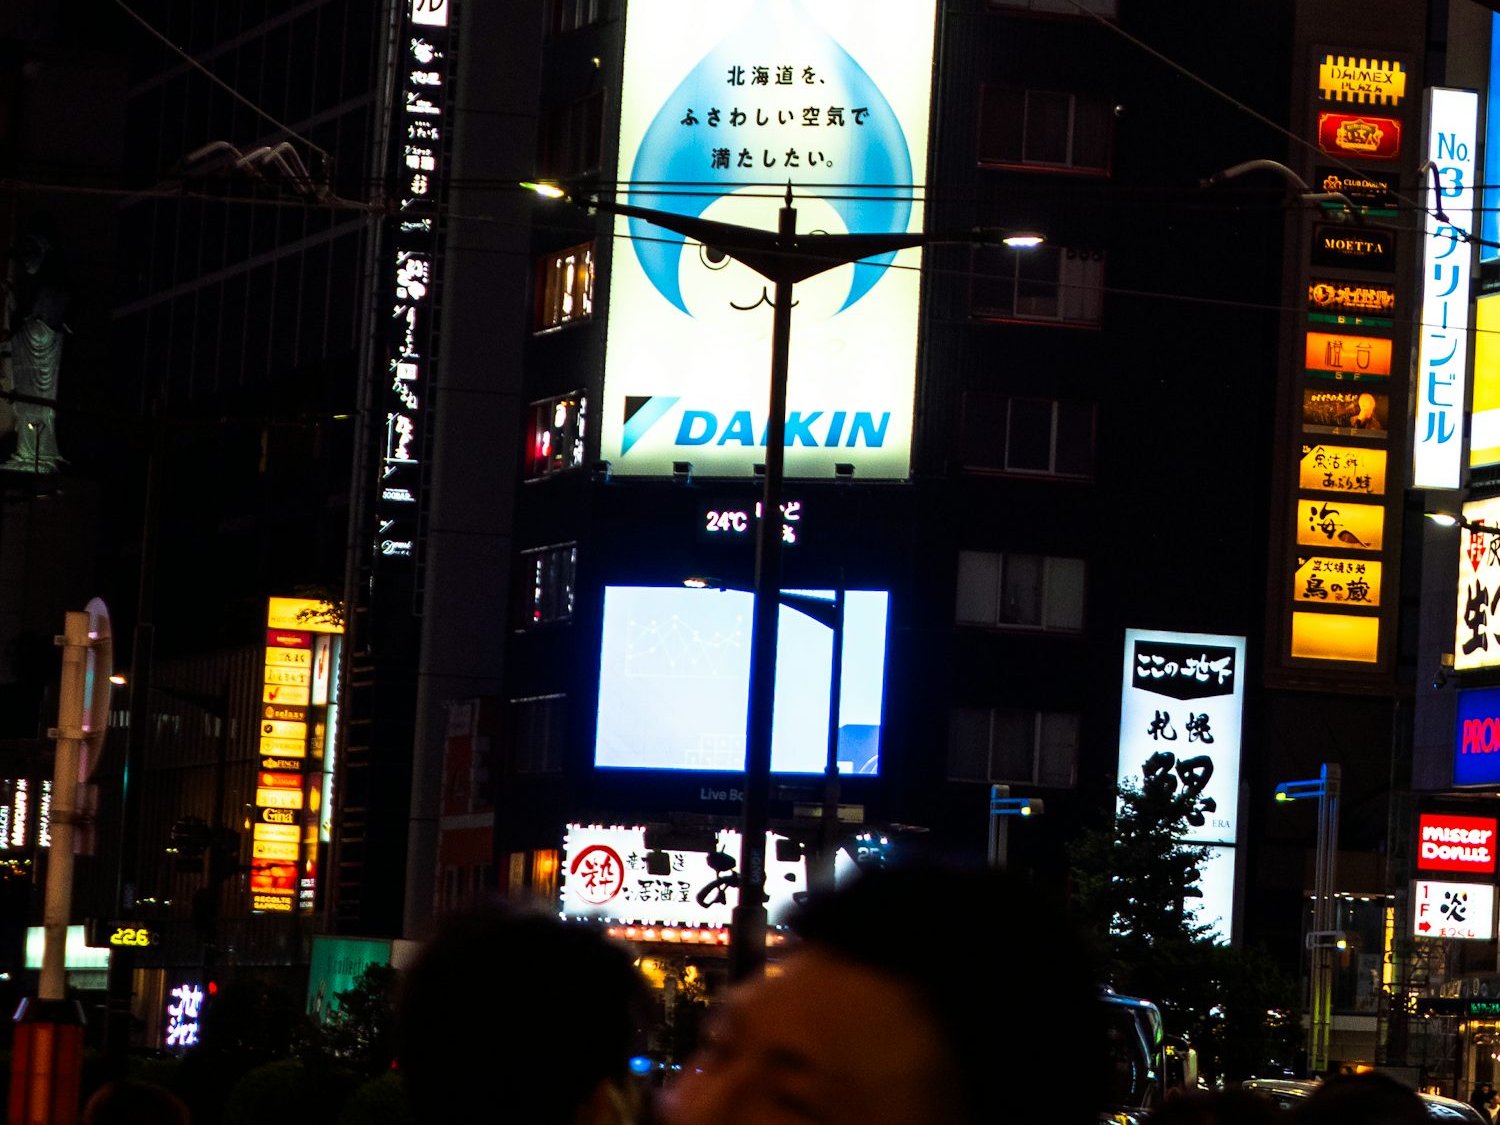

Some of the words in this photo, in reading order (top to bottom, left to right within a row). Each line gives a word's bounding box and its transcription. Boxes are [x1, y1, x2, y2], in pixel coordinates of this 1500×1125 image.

[727, 64, 826, 86] 北海道を、
[680, 106, 870, 129] ふさわしい空気で
[711, 148, 834, 171] 満たしたい。
[1437, 132, 1470, 162] No.
[1438, 166, 1463, 199] 3
[1422, 225, 1459, 444] グリーンビル
[1136, 654, 1233, 685] ここの地下
[1148, 711, 1215, 744] 札幌
